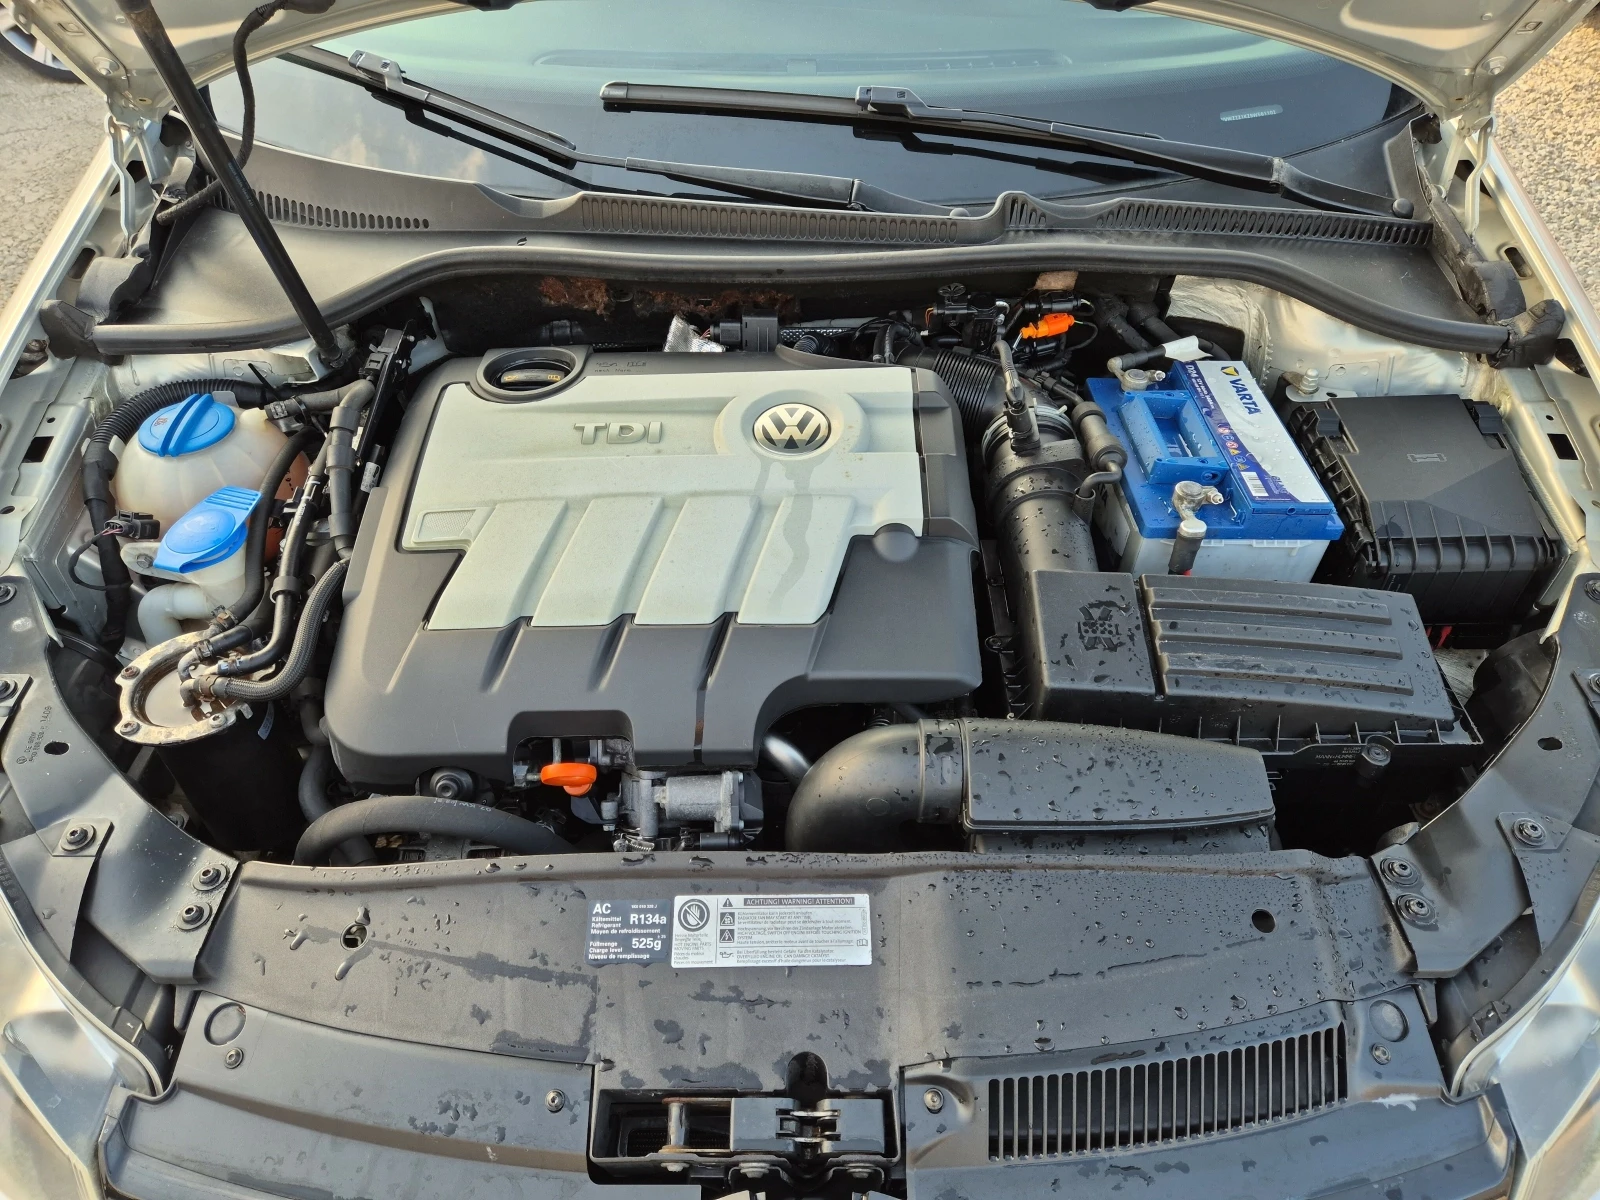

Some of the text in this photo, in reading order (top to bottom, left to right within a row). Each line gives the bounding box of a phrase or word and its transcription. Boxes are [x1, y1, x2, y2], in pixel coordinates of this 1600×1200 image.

[1229, 378, 1261, 415] VARTA
[574, 421, 662, 445] TDI
[753, 402, 832, 454] VW
[592, 903, 611, 915] AC
[629, 913, 667, 925] R134a
[631, 937, 662, 951] 525g
